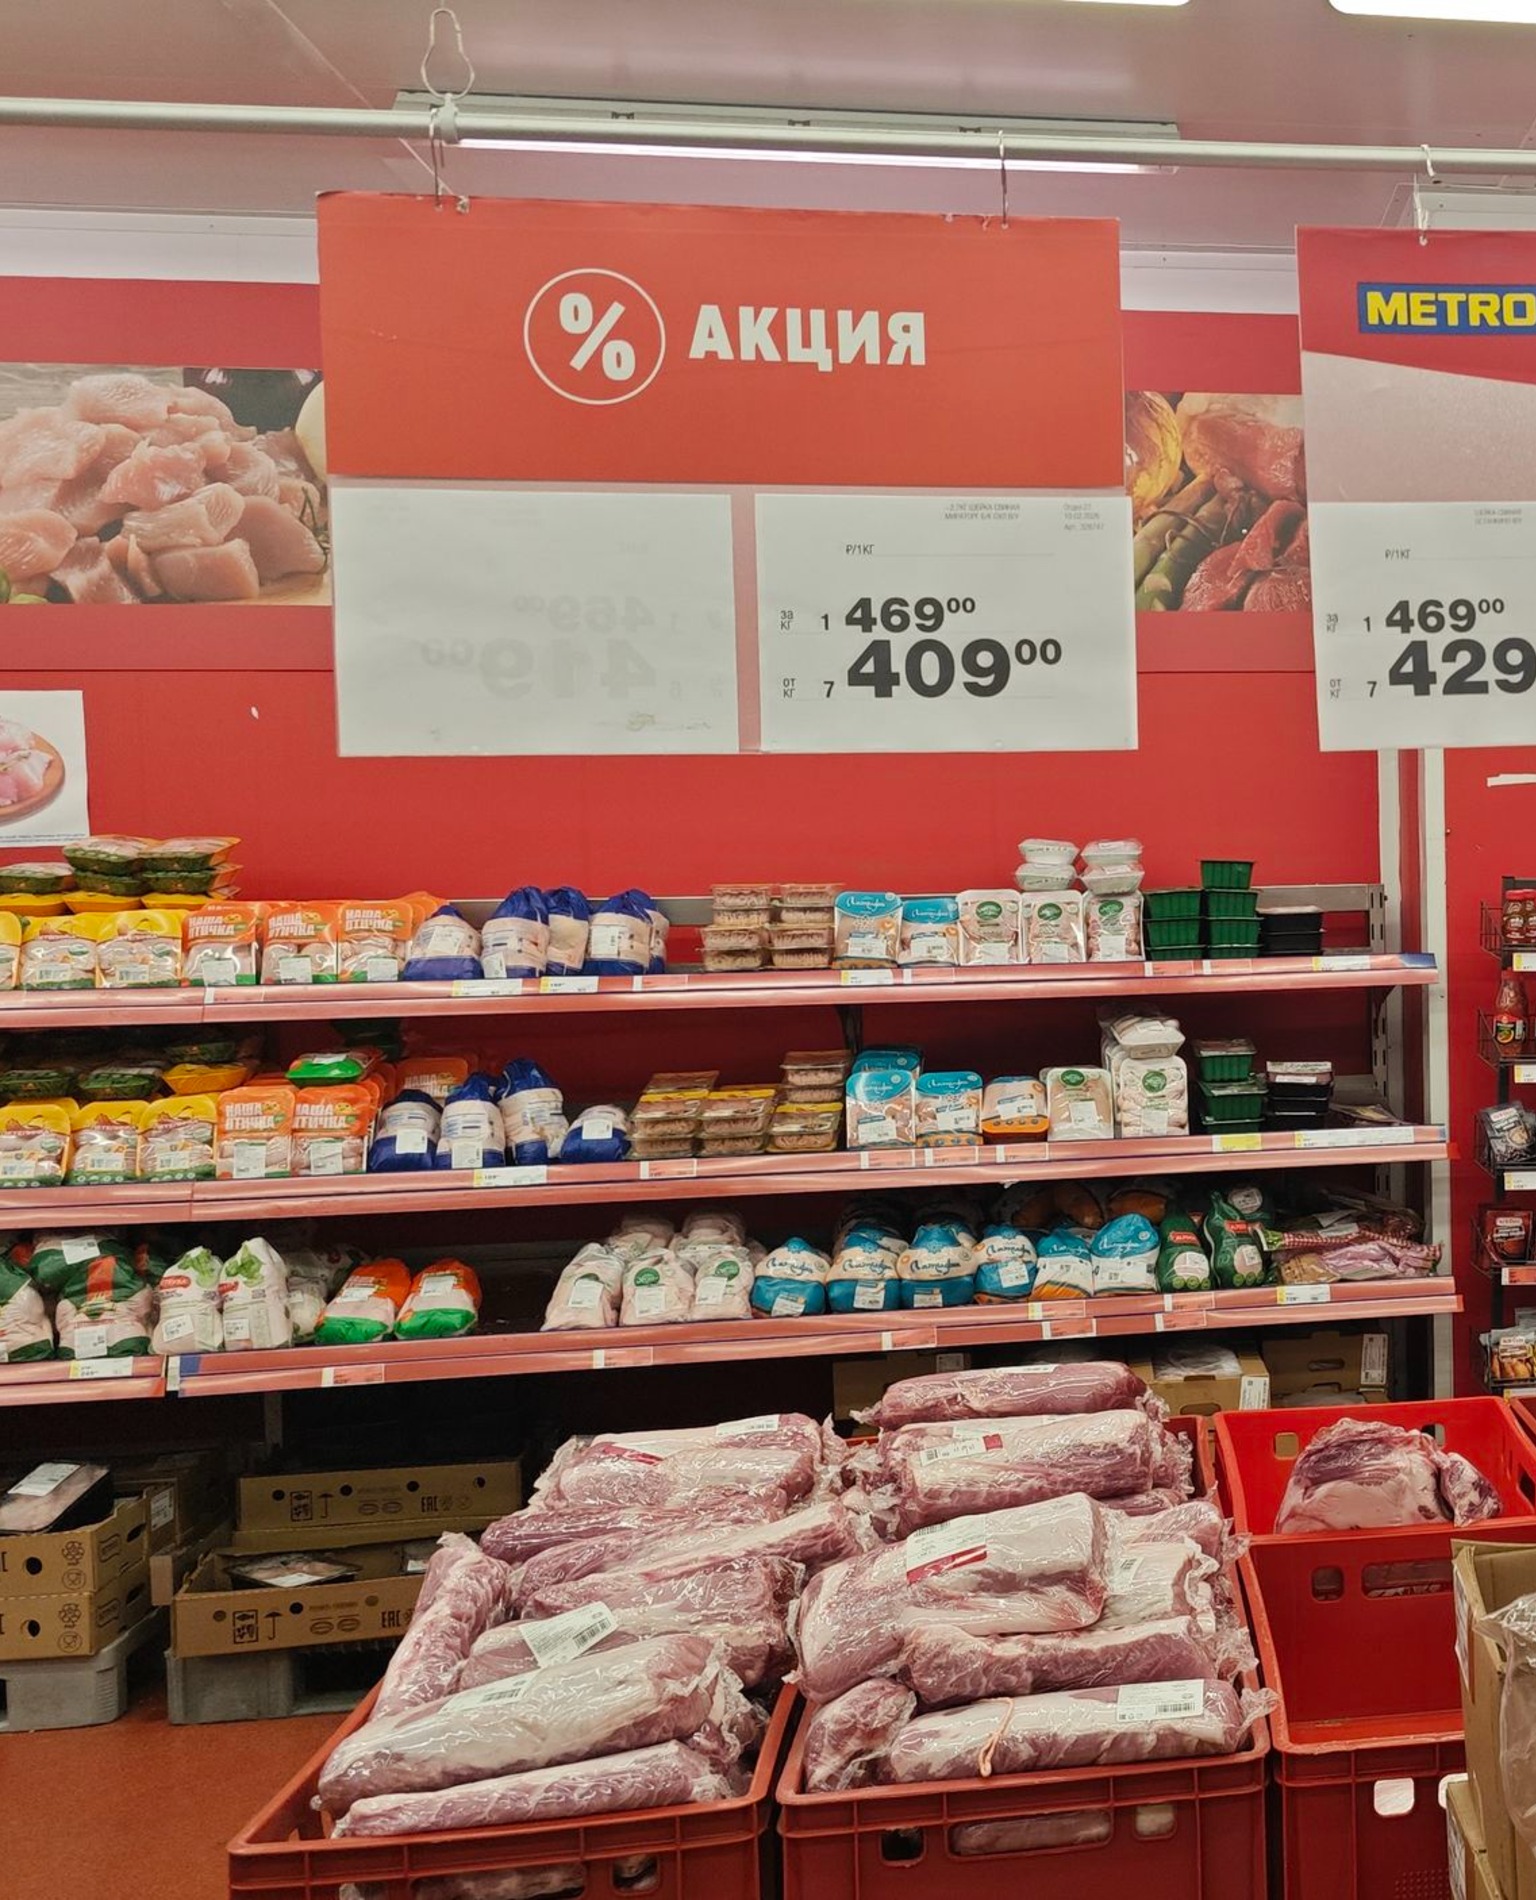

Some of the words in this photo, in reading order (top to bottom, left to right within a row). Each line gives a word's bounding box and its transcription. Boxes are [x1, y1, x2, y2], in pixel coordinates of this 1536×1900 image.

[688, 304, 927, 373] АКЦИЯ
[820, 613, 830, 631] 1
[1363, 616, 1372, 632] 1
[823, 681, 835, 698] 7
[1366, 681, 1378, 698] 7
